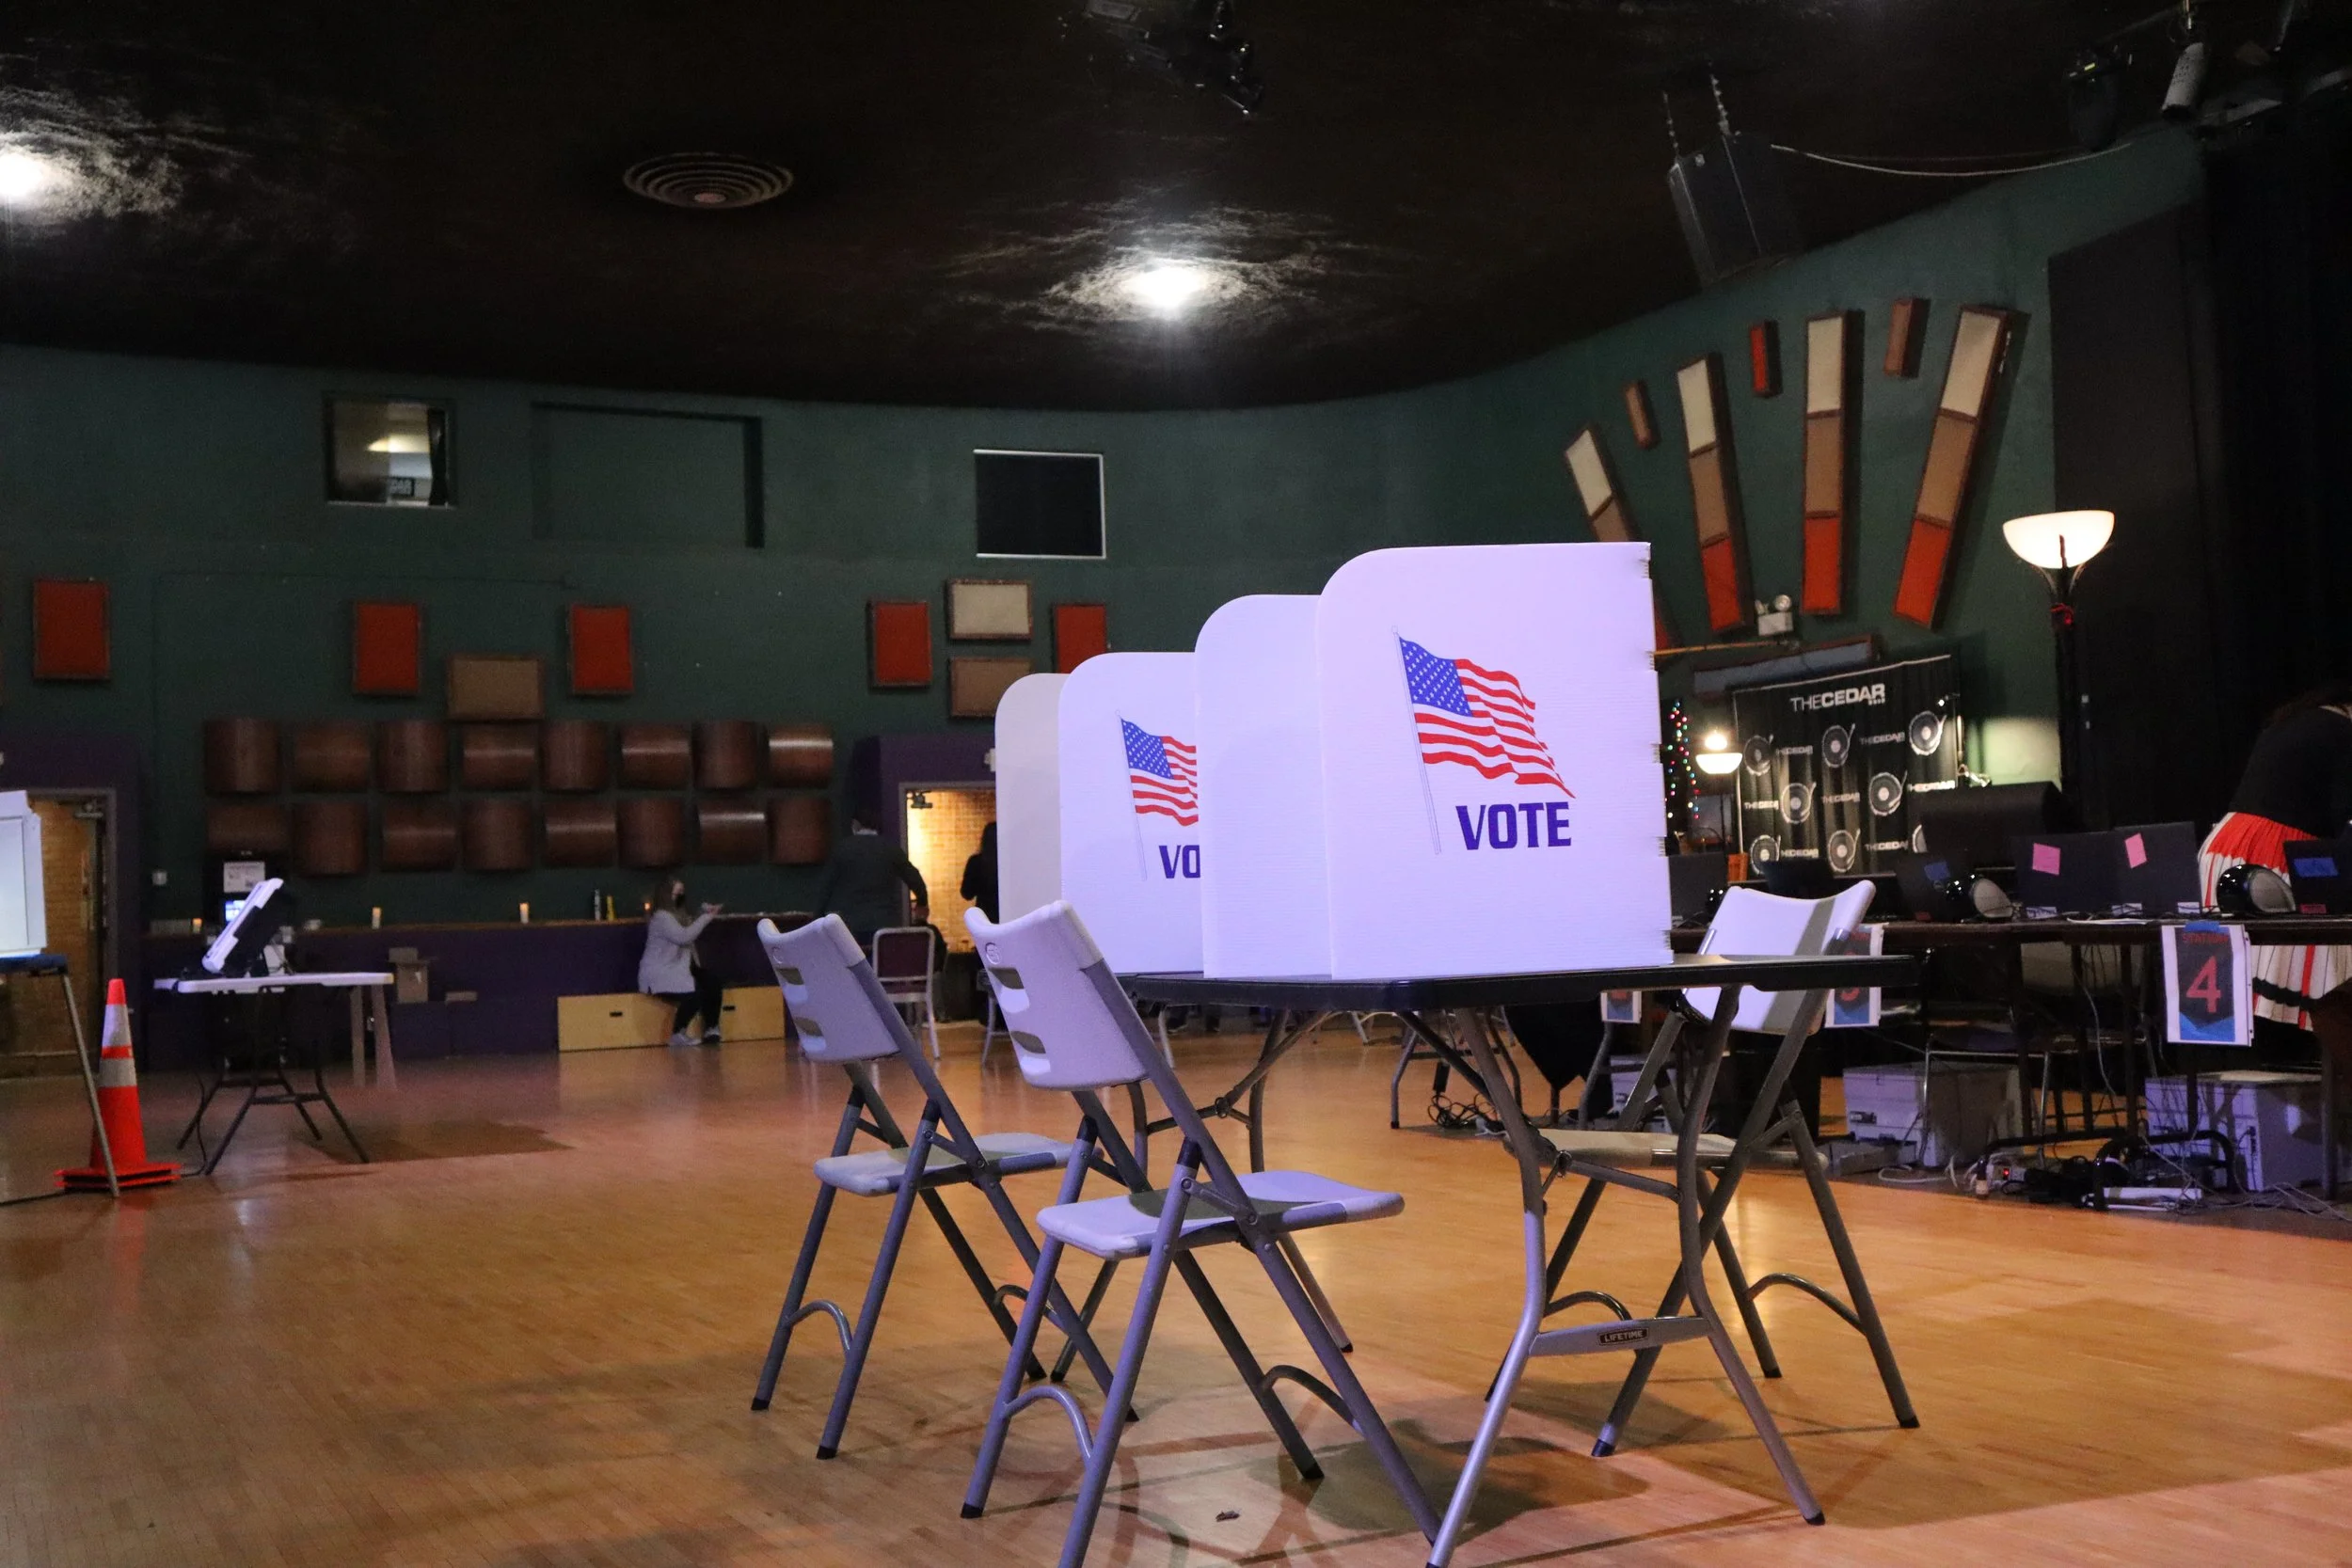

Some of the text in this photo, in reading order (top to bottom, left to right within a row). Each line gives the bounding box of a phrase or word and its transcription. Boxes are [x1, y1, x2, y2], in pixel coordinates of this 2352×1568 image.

[1789, 683, 1885, 712] THECEDAR
[1455, 801, 1572, 851] VOTE
[2186, 956, 2221, 1014] 4
[1603, 1330, 1644, 1343] LIFETIME
